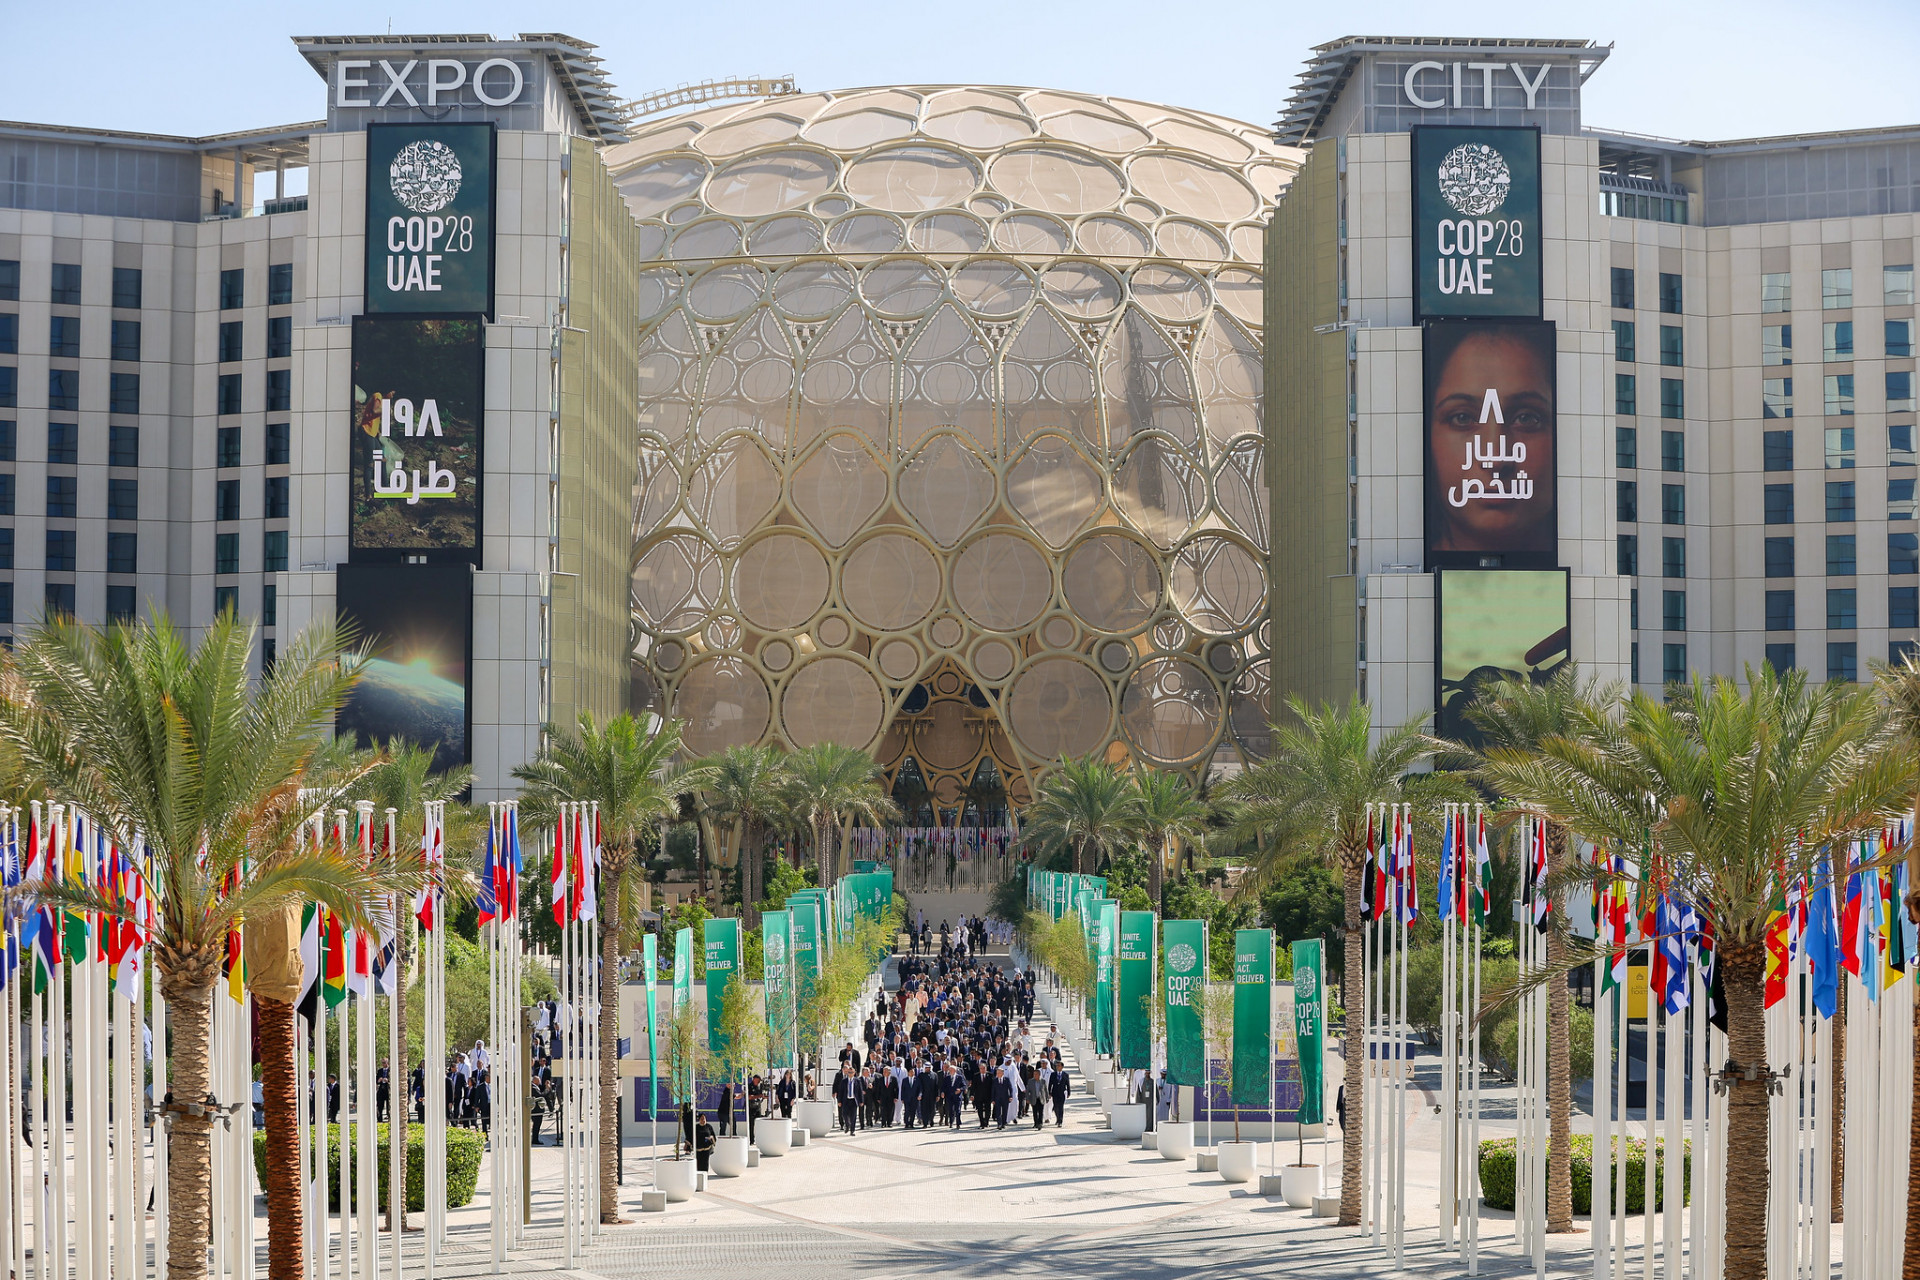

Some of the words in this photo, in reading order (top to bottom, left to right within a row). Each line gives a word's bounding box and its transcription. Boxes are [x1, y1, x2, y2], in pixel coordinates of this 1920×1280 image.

[337, 58, 523, 108] EXPO
[1404, 60, 1552, 110] CITY
[387, 215, 473, 253] COP28
[1438, 218, 1523, 256] COP28
[386, 255, 443, 292] UAE
[1438, 258, 1494, 295] UAE
[1479, 388, 1505, 424] ٨
[381, 398, 443, 437] ١٩٨
[1461, 434, 1526, 471] مليار
[1448, 470, 1533, 507] شخص
[706, 941, 725, 950] UNITE.
[1122, 933, 1141, 941] UNITE.
[1122, 942, 1135, 950] ACT.
[706, 951, 719, 960] ACT.
[1122, 951, 1147, 959] DELIVER.
[1237, 953, 1258, 962] UNITE.
[706, 960, 733, 970] DELIVER.
[1236, 964, 1250, 973] ACT.
[1168, 976, 1202, 991] COP28
[1237, 974, 1266, 983] DELIVER.
[1168, 991, 1190, 1006] UAE
[1296, 1001, 1320, 1019] OP28
[1299, 1019, 1313, 1036] AE
